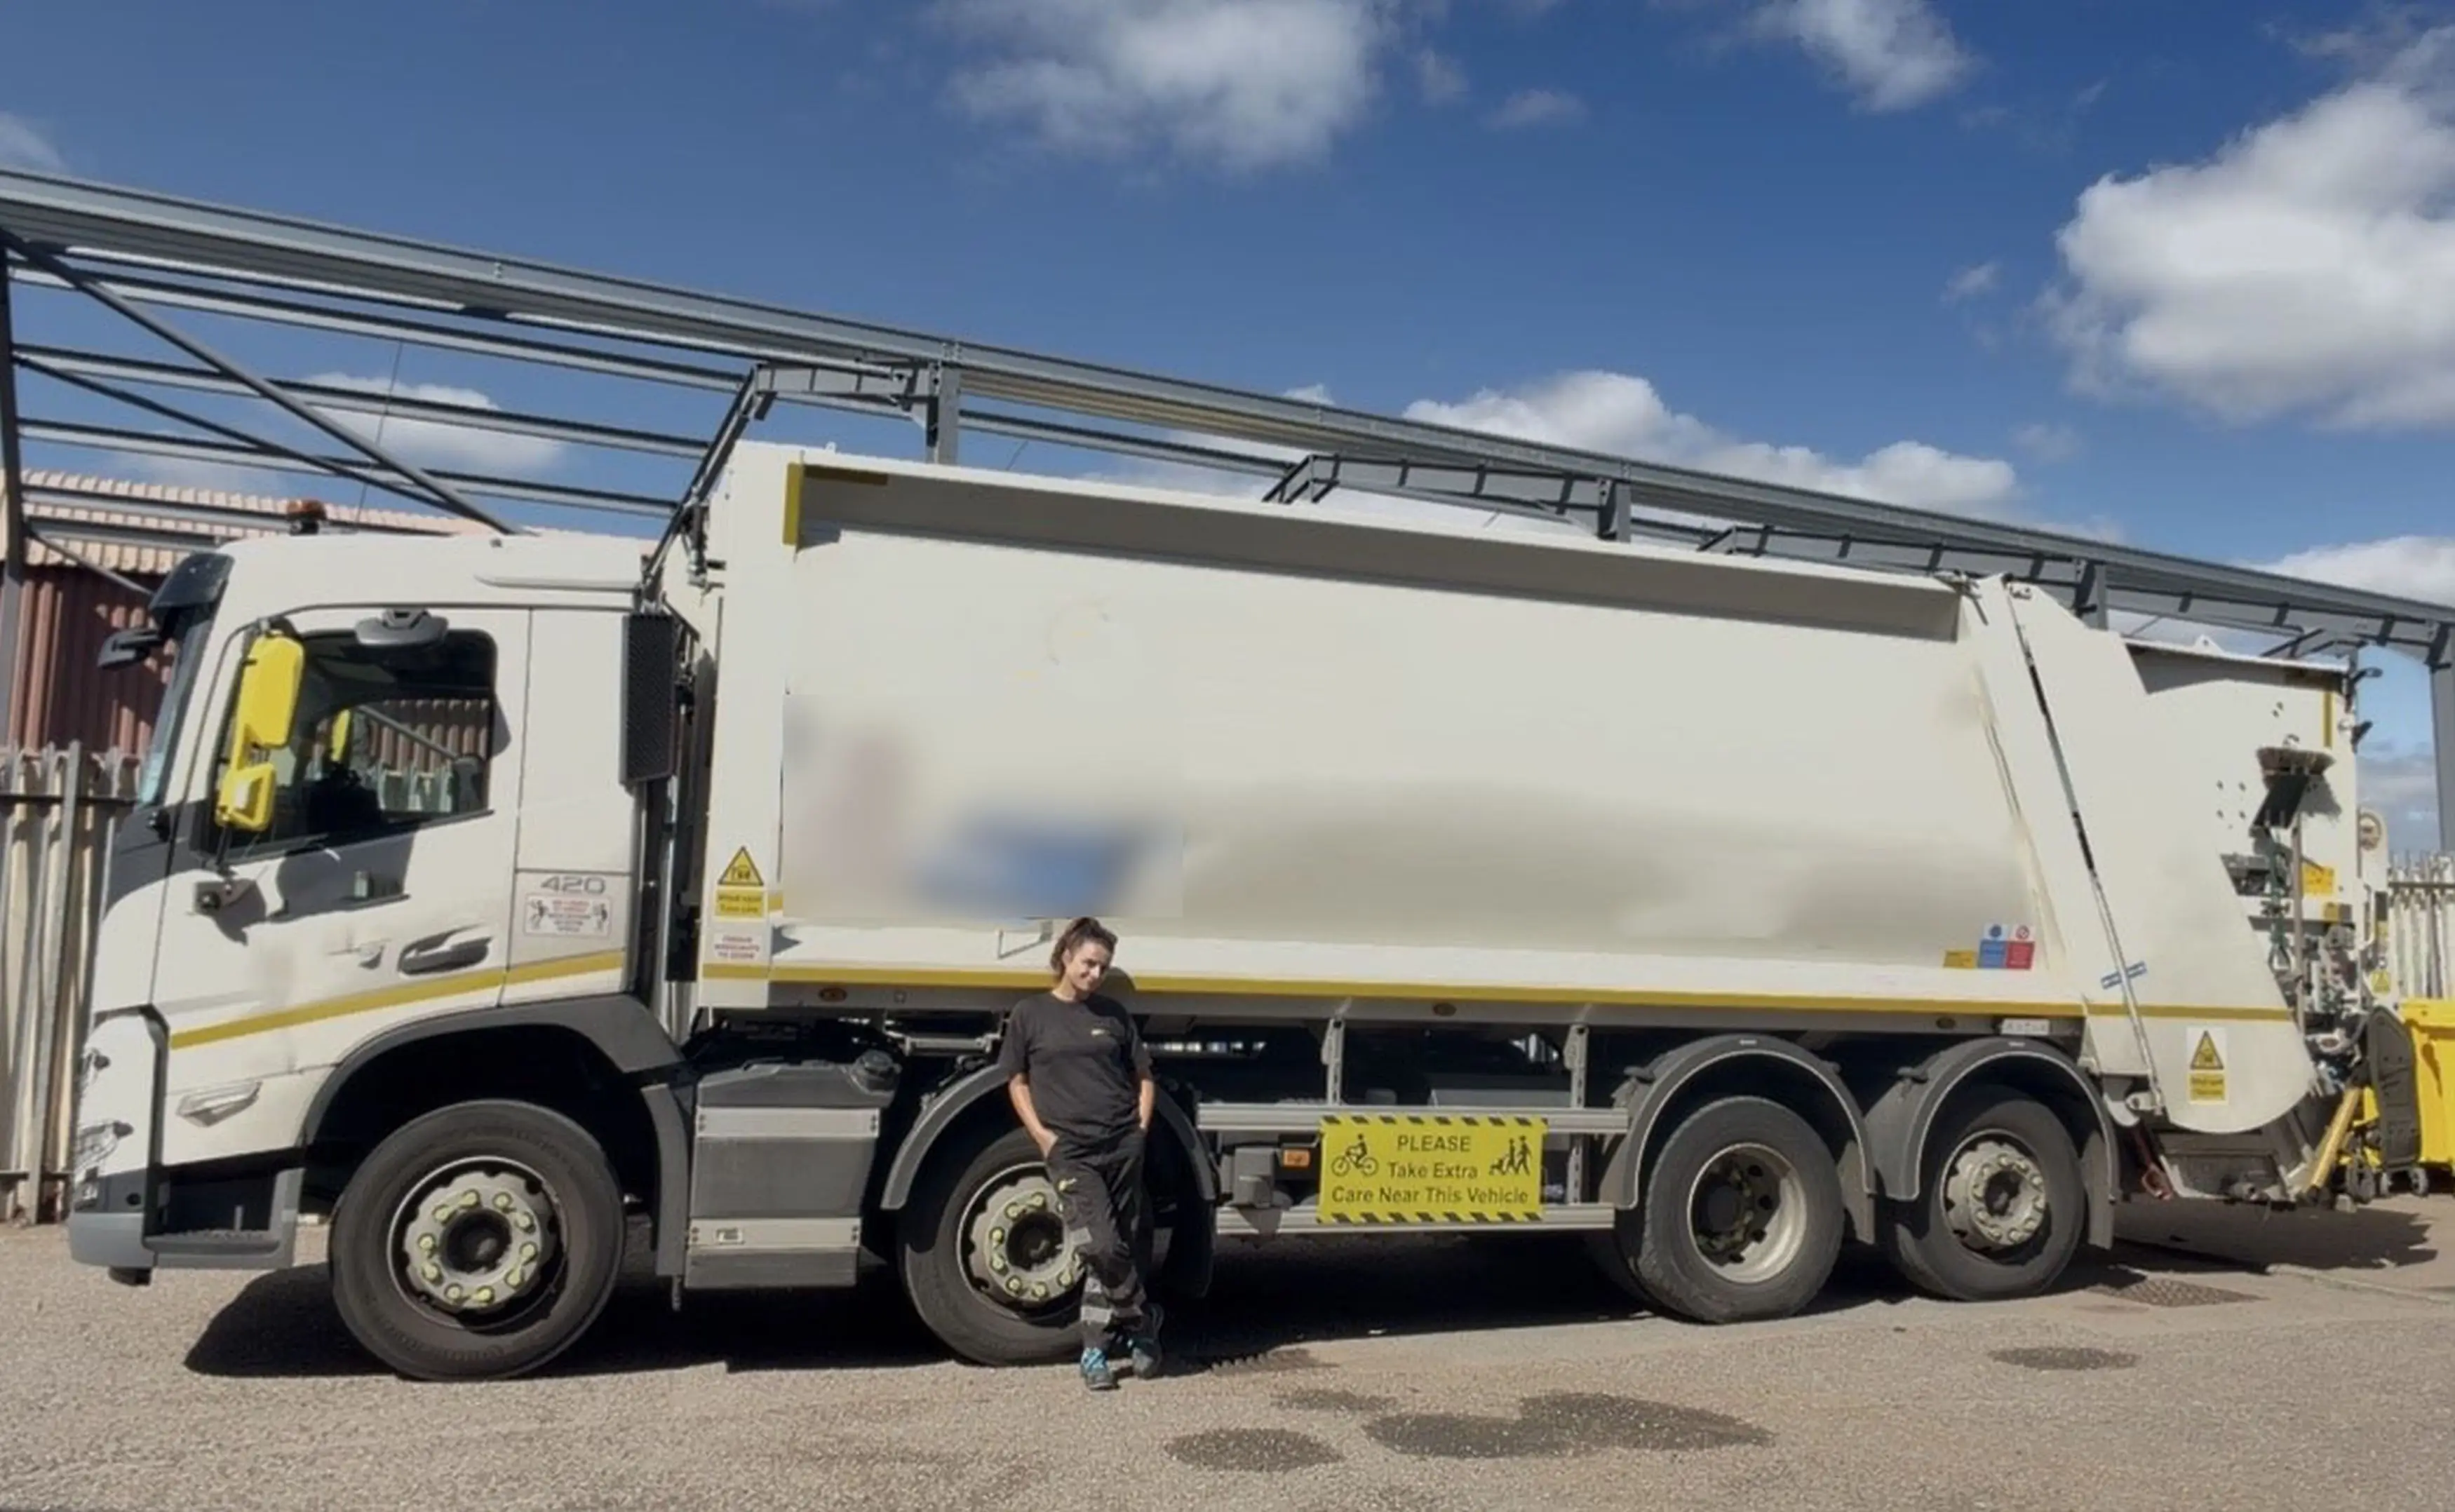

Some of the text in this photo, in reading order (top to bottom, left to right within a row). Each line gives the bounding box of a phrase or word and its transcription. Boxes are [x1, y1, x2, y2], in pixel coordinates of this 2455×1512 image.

[541, 876, 606, 895] 420
[1397, 1135, 1472, 1152] PLEASE
[1387, 1162, 1478, 1180] Take Extra
[1332, 1186, 1529, 1205] Care Near This Vehicle
